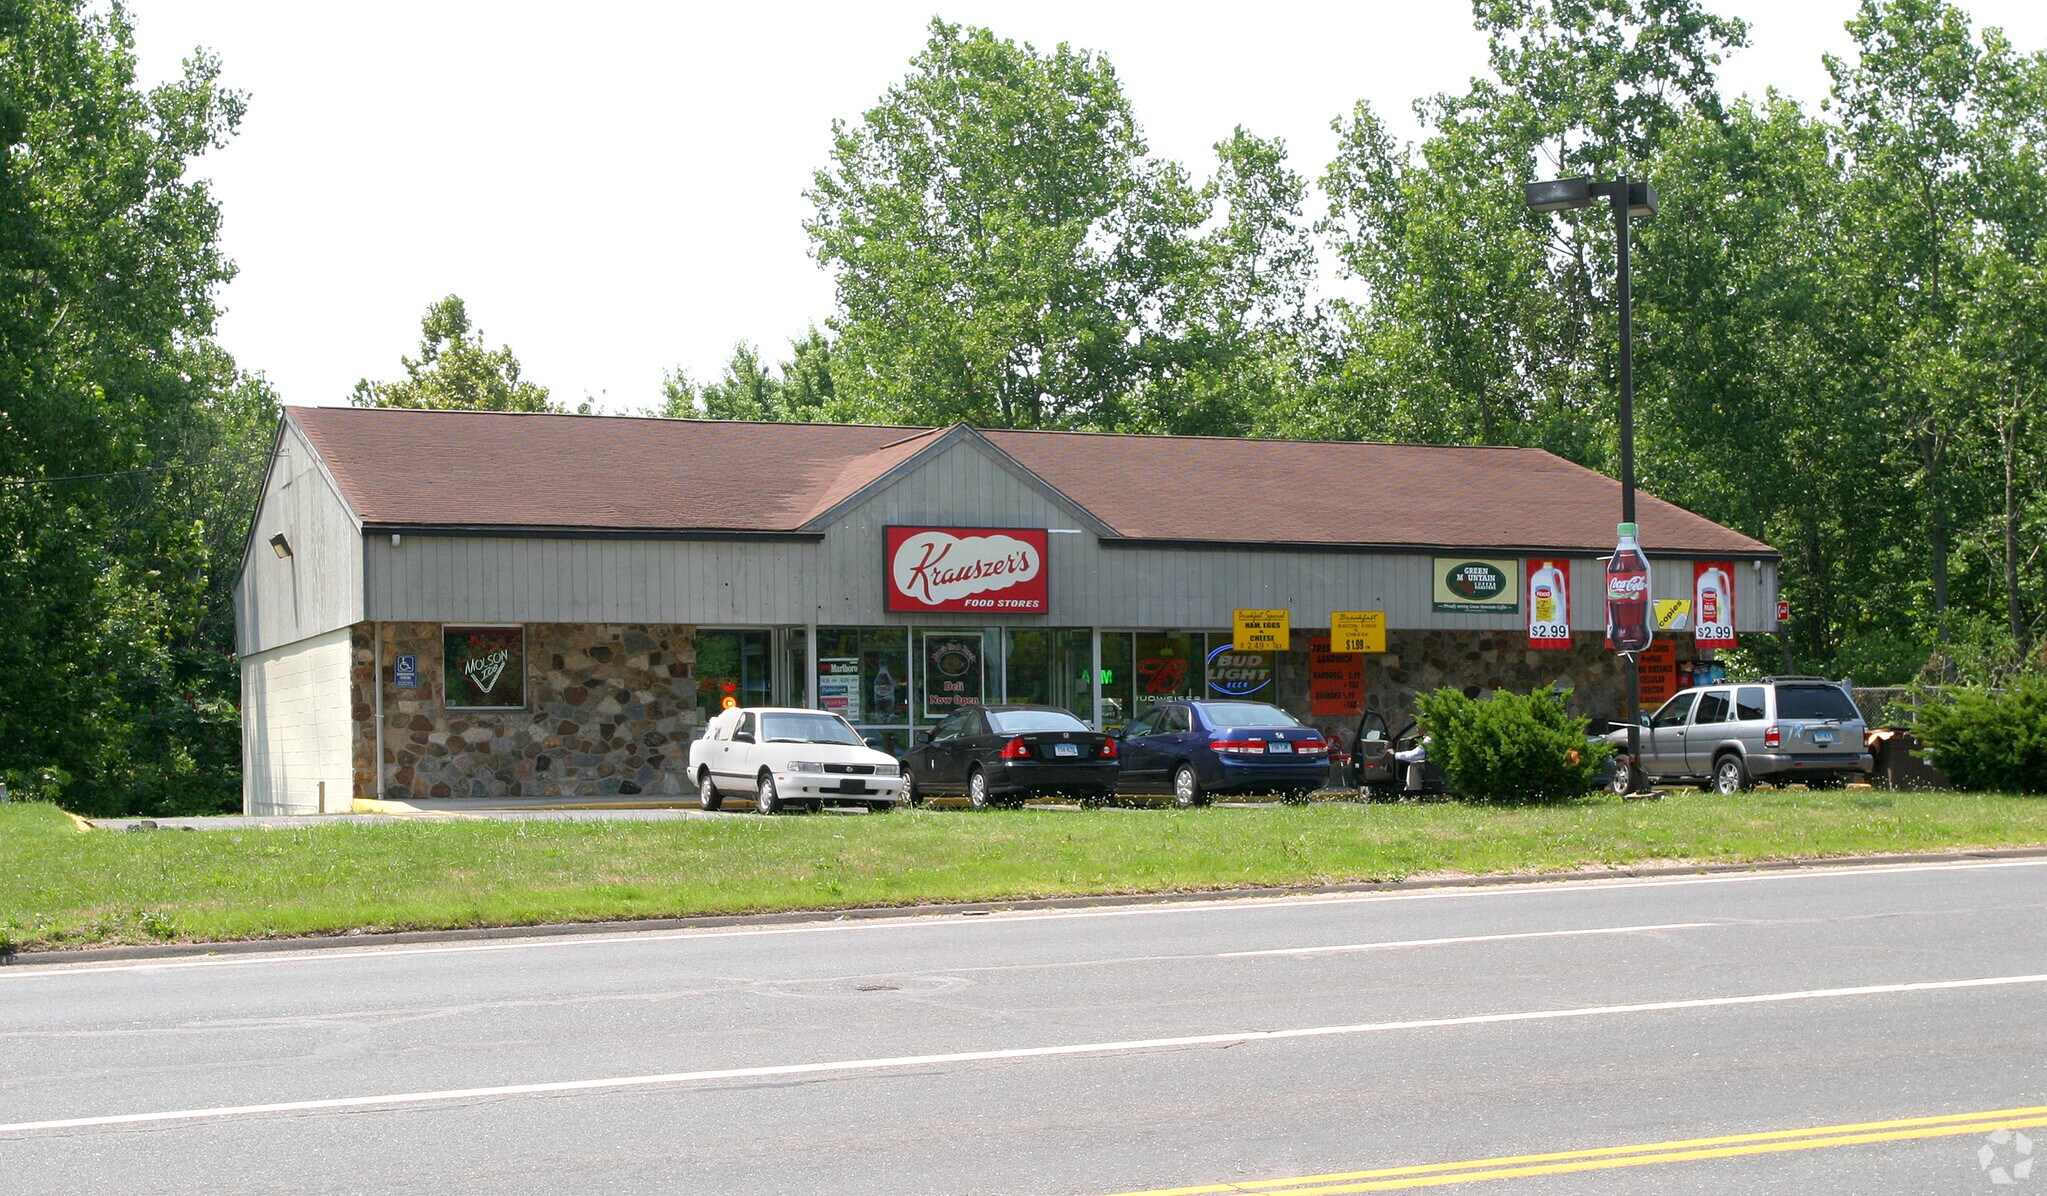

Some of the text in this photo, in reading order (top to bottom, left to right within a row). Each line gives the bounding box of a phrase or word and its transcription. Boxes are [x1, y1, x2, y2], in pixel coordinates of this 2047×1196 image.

[907, 543, 1030, 602] Krauszer's
[997, 600, 1039, 608] STORES
[1339, 614, 1378, 624] Breakfast
[1659, 600, 1682, 627] copies
[1532, 625, 1566, 638] $2.99
[1697, 626, 1731, 639] $2.99
[1312, 644, 1331, 652] FRES
[465, 649, 508, 675] MOLSON
[1217, 655, 1263, 667] BUD
[831, 664, 858, 673] Marlboro
[1207, 669, 1270, 680] LIGHT
[1081, 669, 1113, 684] AM
[943, 681, 965, 691] Deli
[929, 694, 979, 706] Now Open
